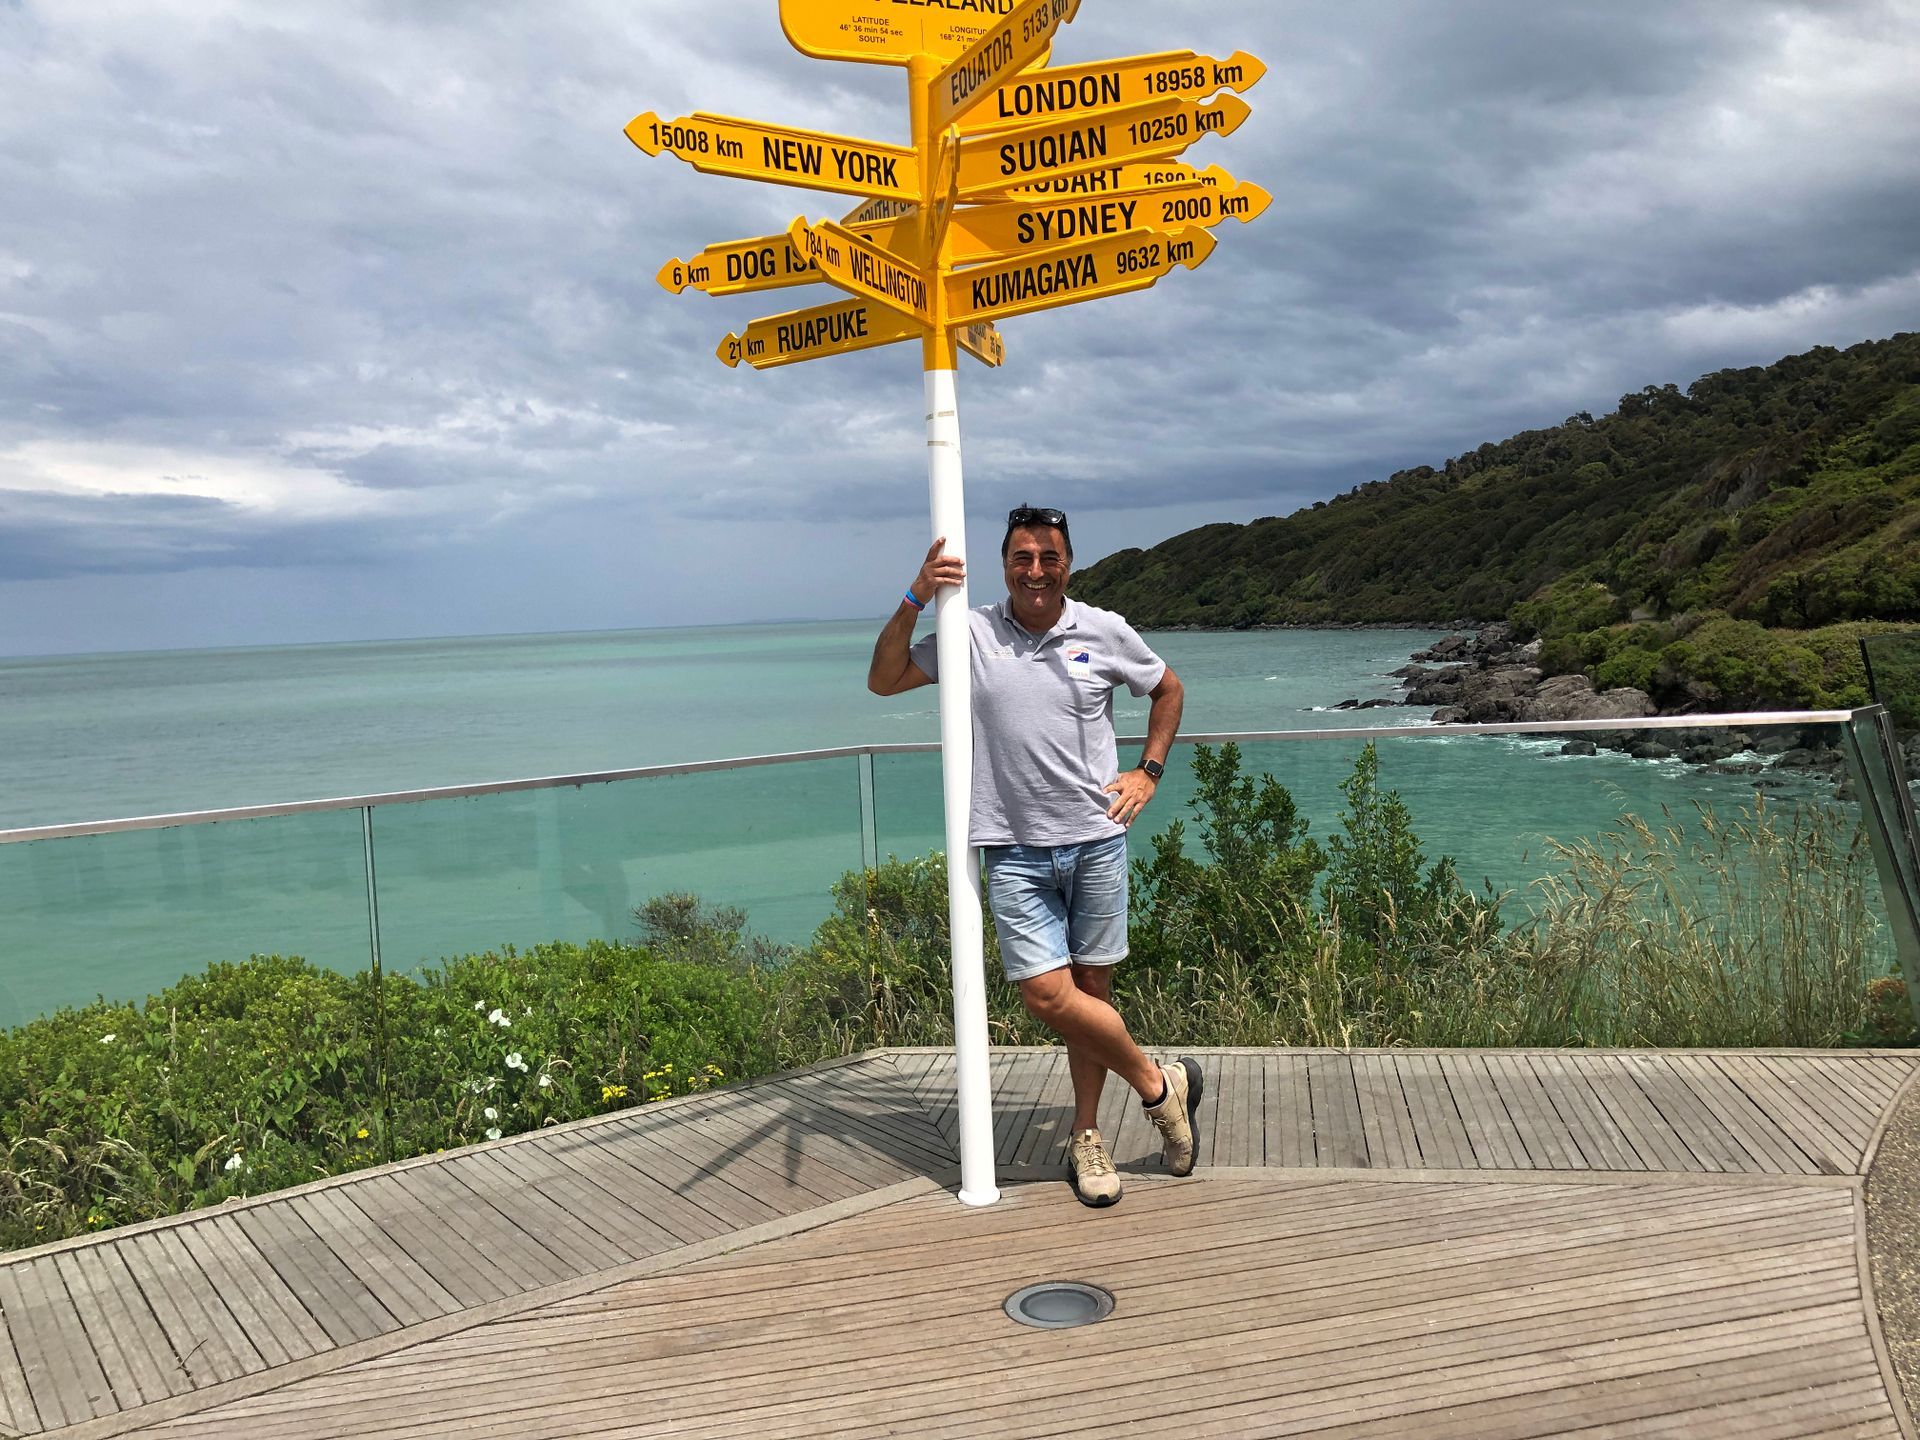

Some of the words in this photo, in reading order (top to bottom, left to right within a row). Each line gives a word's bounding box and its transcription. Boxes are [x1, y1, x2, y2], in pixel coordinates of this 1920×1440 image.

[852, 16, 890, 26] LATITUDE
[858, 35, 886, 44] SOUTH
[864, 26, 878, 34] min
[880, 27, 889, 35] 54
[956, 34, 965, 42] 21
[951, 28, 1013, 106] EQUATOR
[1023, 3, 1049, 43] 5133
[999, 72, 1121, 118] LONDON
[1144, 66, 1206, 95] 18958
[1213, 64, 1244, 86] km
[649, 123, 709, 154] 15008
[716, 133, 744, 159] km
[763, 136, 823, 176] NEW
[831, 147, 899, 189] YORK
[1000, 125, 1107, 176] SUQIAN
[1128, 113, 1188, 145] 10250
[1195, 109, 1225, 132] km
[1017, 200, 1138, 244] SYDNEY
[1162, 196, 1212, 223] 2000
[1219, 194, 1250, 216] km
[672, 269, 682, 285] 6
[687, 263, 711, 283] km
[726, 247, 776, 282] DOG
[803, 228, 823, 259] 784
[825, 238, 841, 268] km
[849, 245, 928, 312] WELLINGTON
[972, 253, 1098, 310] KUMAGAYA
[1116, 247, 1161, 275] 9632
[1167, 240, 1195, 263] km
[728, 341, 743, 360] 21
[747, 336, 766, 356] km
[777, 308, 868, 352] RUAPUKE
